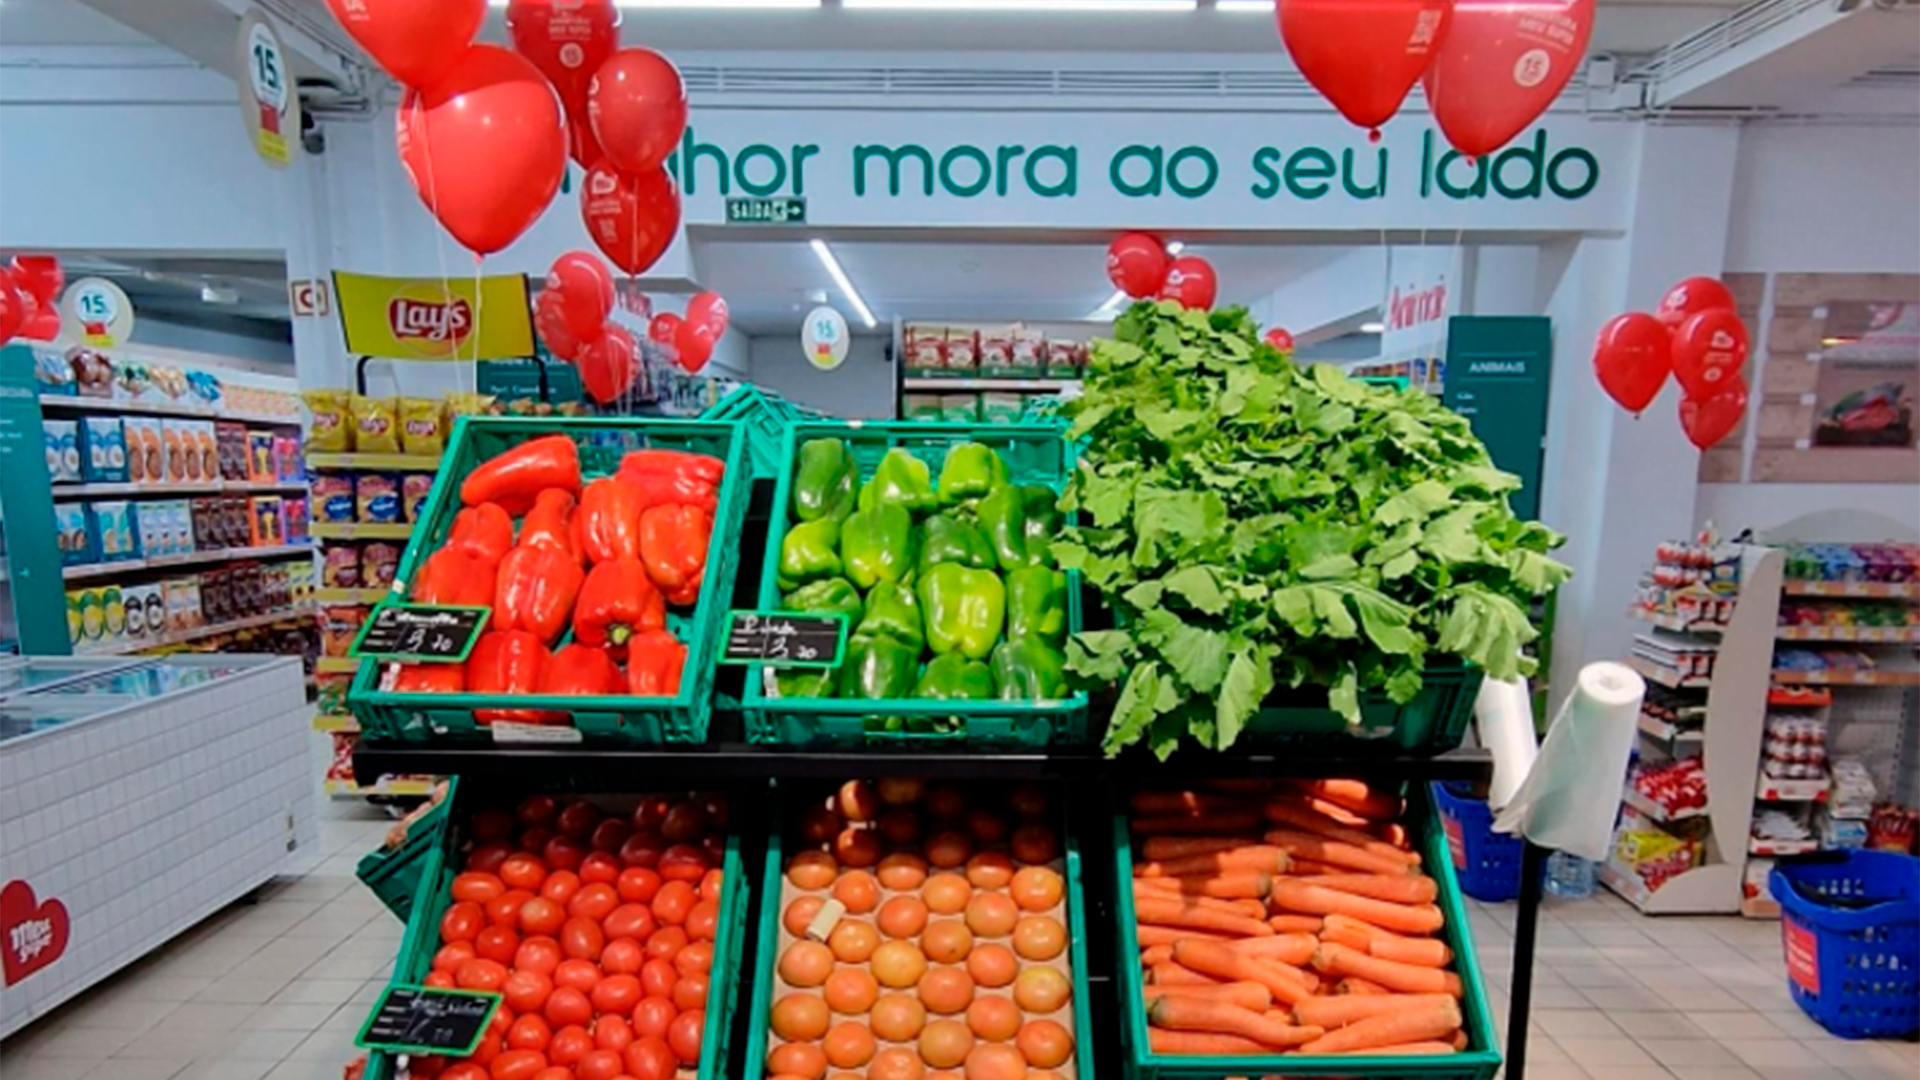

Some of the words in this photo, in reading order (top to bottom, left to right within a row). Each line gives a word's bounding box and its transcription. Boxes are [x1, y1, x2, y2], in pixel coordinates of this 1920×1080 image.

[254, 44, 279, 89] 15
[853, 144, 1077, 197] mora
[1109, 145, 1218, 198] ao
[1252, 147, 1388, 199] seu
[1420, 128, 1599, 199] lado
[81, 295, 108, 314] 15
